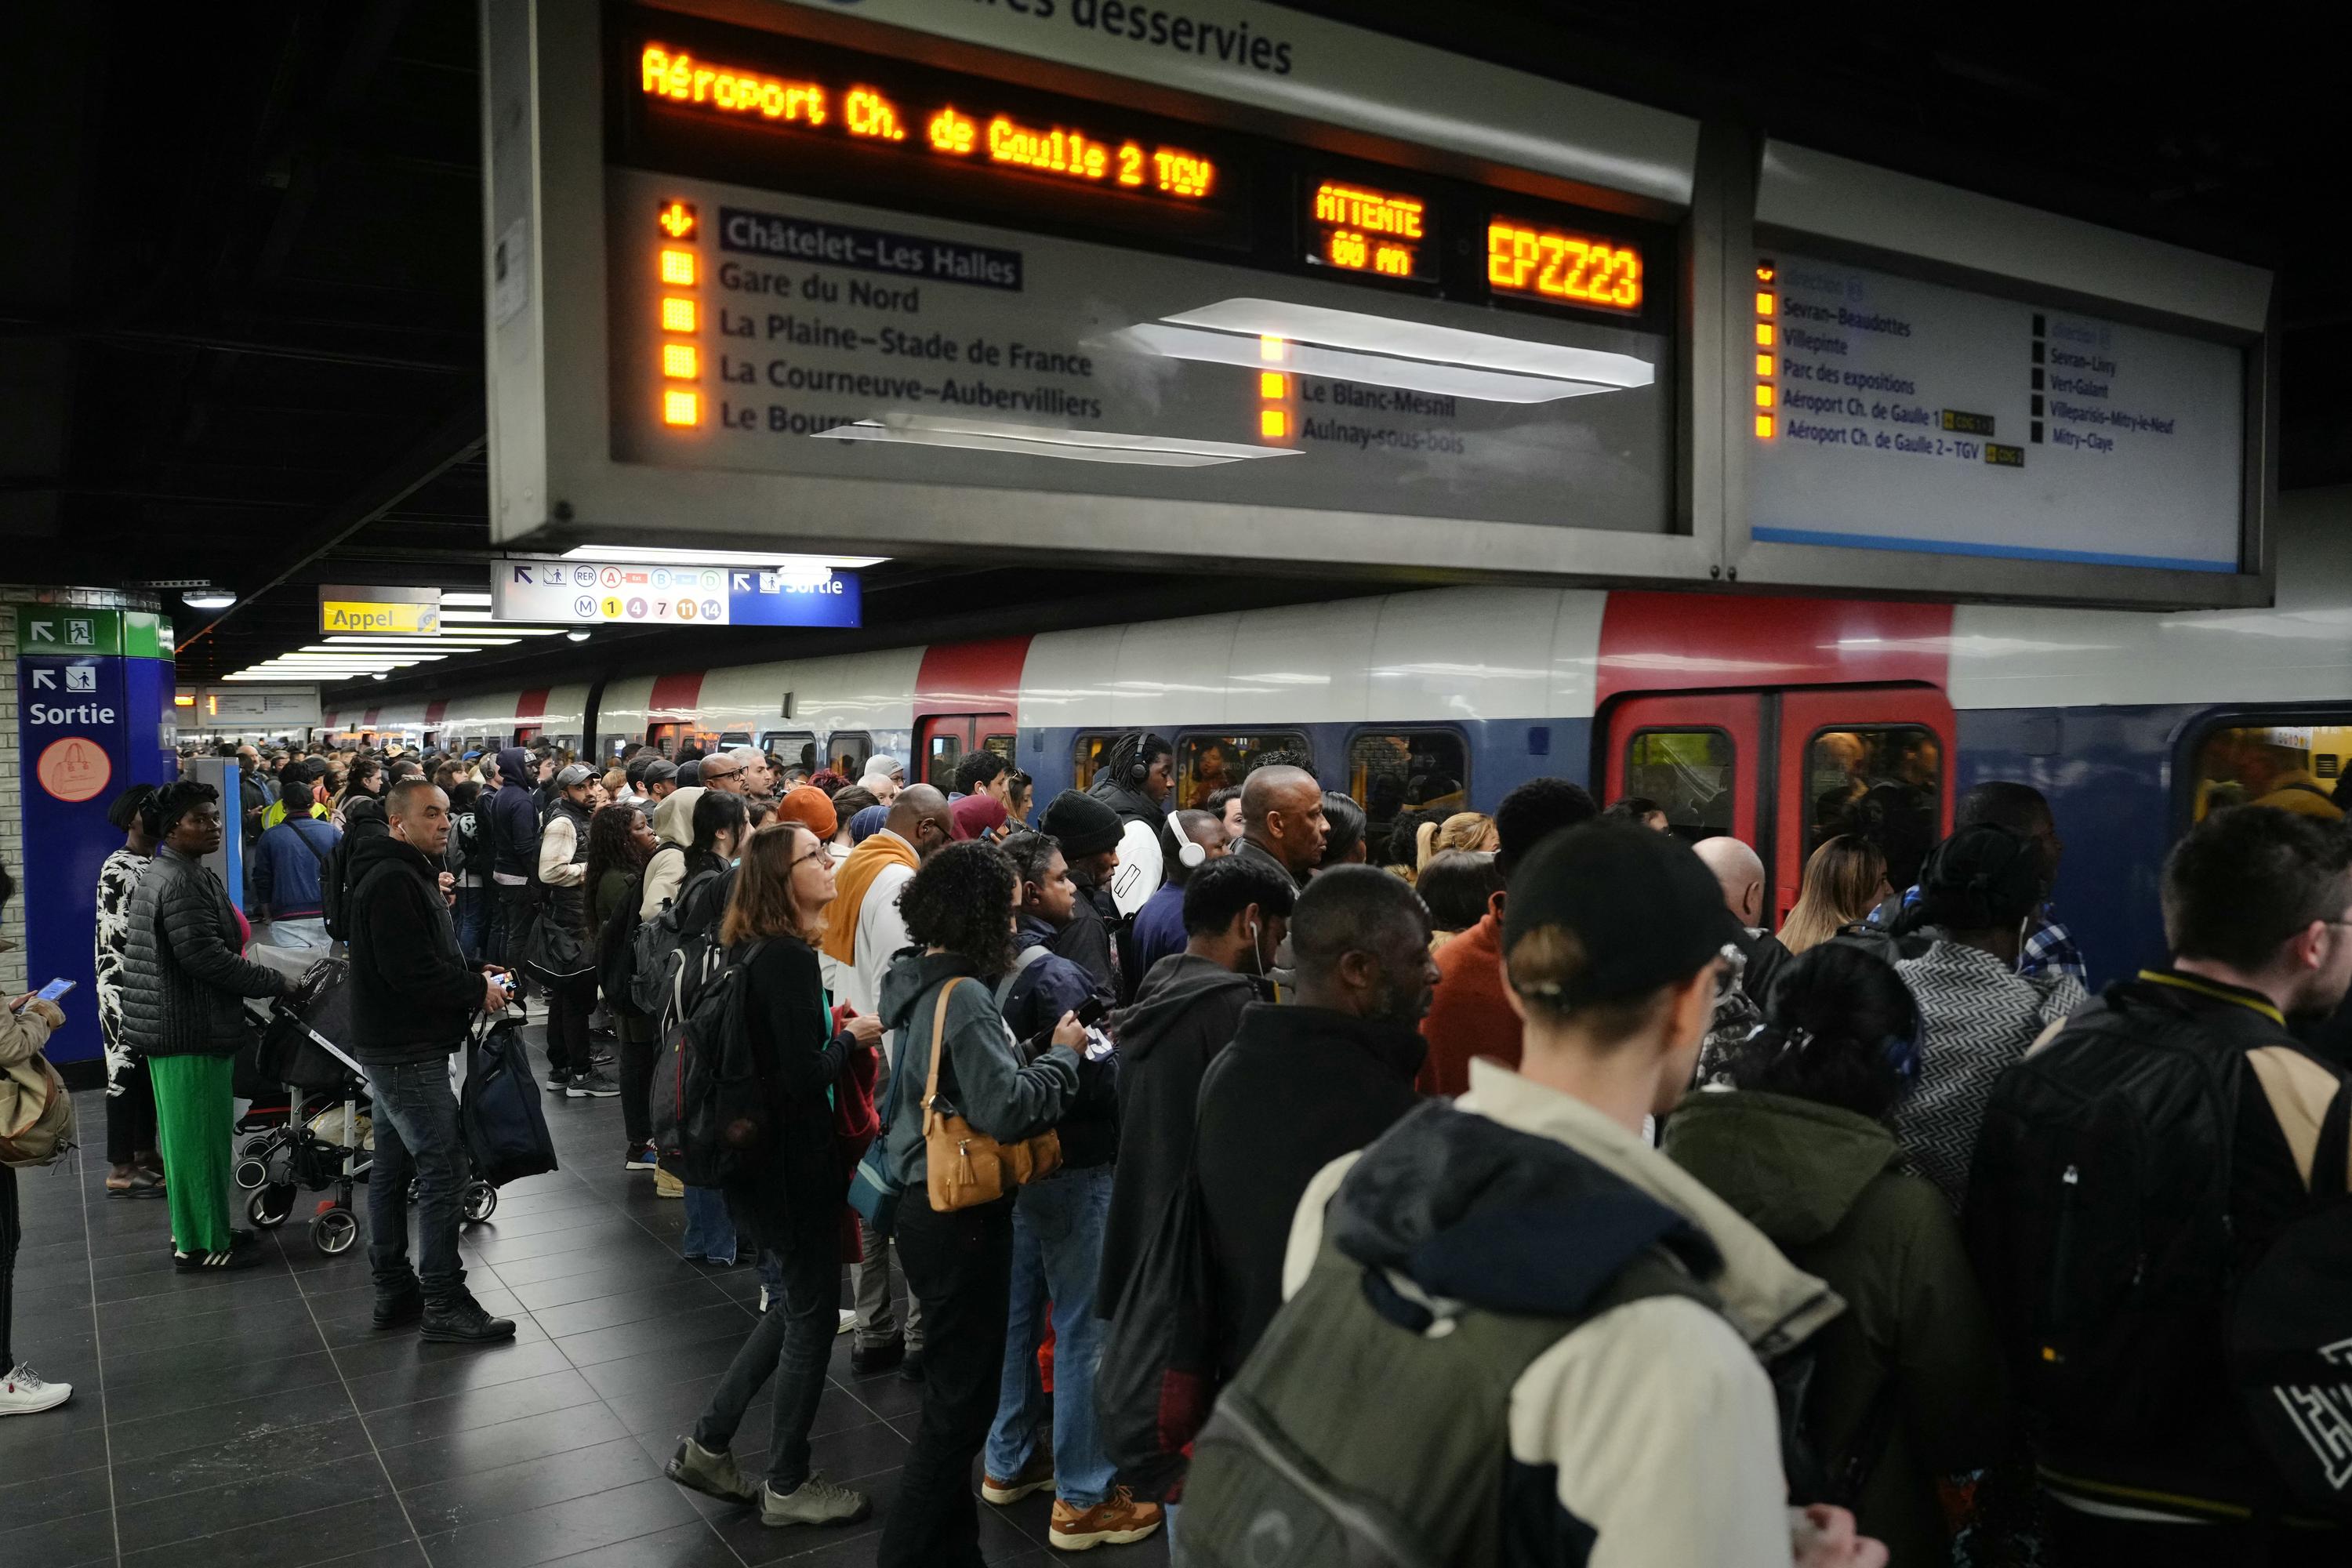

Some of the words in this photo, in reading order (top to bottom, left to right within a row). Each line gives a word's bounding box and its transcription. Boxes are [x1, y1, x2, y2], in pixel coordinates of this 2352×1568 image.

[1072, 0, 1292, 74] desservies
[643, 49, 824, 124] Aéroport
[848, 92, 902, 139] Ch.
[931, 110, 973, 151] de
[990, 119, 1104, 177] Gaulle
[1119, 146, 1141, 184] 2
[1153, 152, 1208, 196] TGV
[1316, 185, 1421, 238] ATTENTE
[728, 216, 924, 271] Châtelet-Les
[933, 248, 1015, 284] Halles
[720, 263, 790, 297] Gare
[803, 274, 838, 303] du
[849, 280, 920, 312] Nord
[720, 308, 755, 339] La
[767, 314, 958, 361] Plaine-Stade
[967, 339, 1000, 366] de
[1009, 343, 1093, 377] France
[1784, 328, 1848, 355] Villepinte
[720, 355, 756, 384] La
[768, 359, 1102, 419] Courneuve-Aubervilliers
[1784, 358, 1811, 379] Parc
[1817, 364, 1839, 384] des
[1844, 370, 1915, 395] expositions
[720, 402, 757, 430] Le
[1301, 382, 1325, 403] Le
[1334, 383, 1456, 417] Blanc-Mesnil
[1784, 389, 1843, 415] Aéroport
[1847, 397, 1867, 418] Ch.
[1871, 401, 1887, 420] de
[1891, 404, 1929, 426] Gaulle
[1933, 410, 1940, 427] 1
[1788, 419, 1846, 445] Aéroport
[1851, 427, 1871, 448] Ch.
[1875, 431, 1891, 450] de
[1895, 434, 1933, 455] Gaulle
[2053, 428, 2114, 453] Mitry-Claye
[577, 572, 594, 581] RER
[606, 572, 616, 583] A
[657, 574, 666, 584] B
[706, 575, 715, 586] D
[332, 609, 393, 630] Appel
[579, 601, 592, 612] M
[607, 601, 615, 614] 1
[630, 602, 641, 615] 4
[658, 602, 666, 615] 7
[679, 603, 694, 616] 11
[702, 603, 720, 617] 14
[30, 702, 115, 725] Sortie
